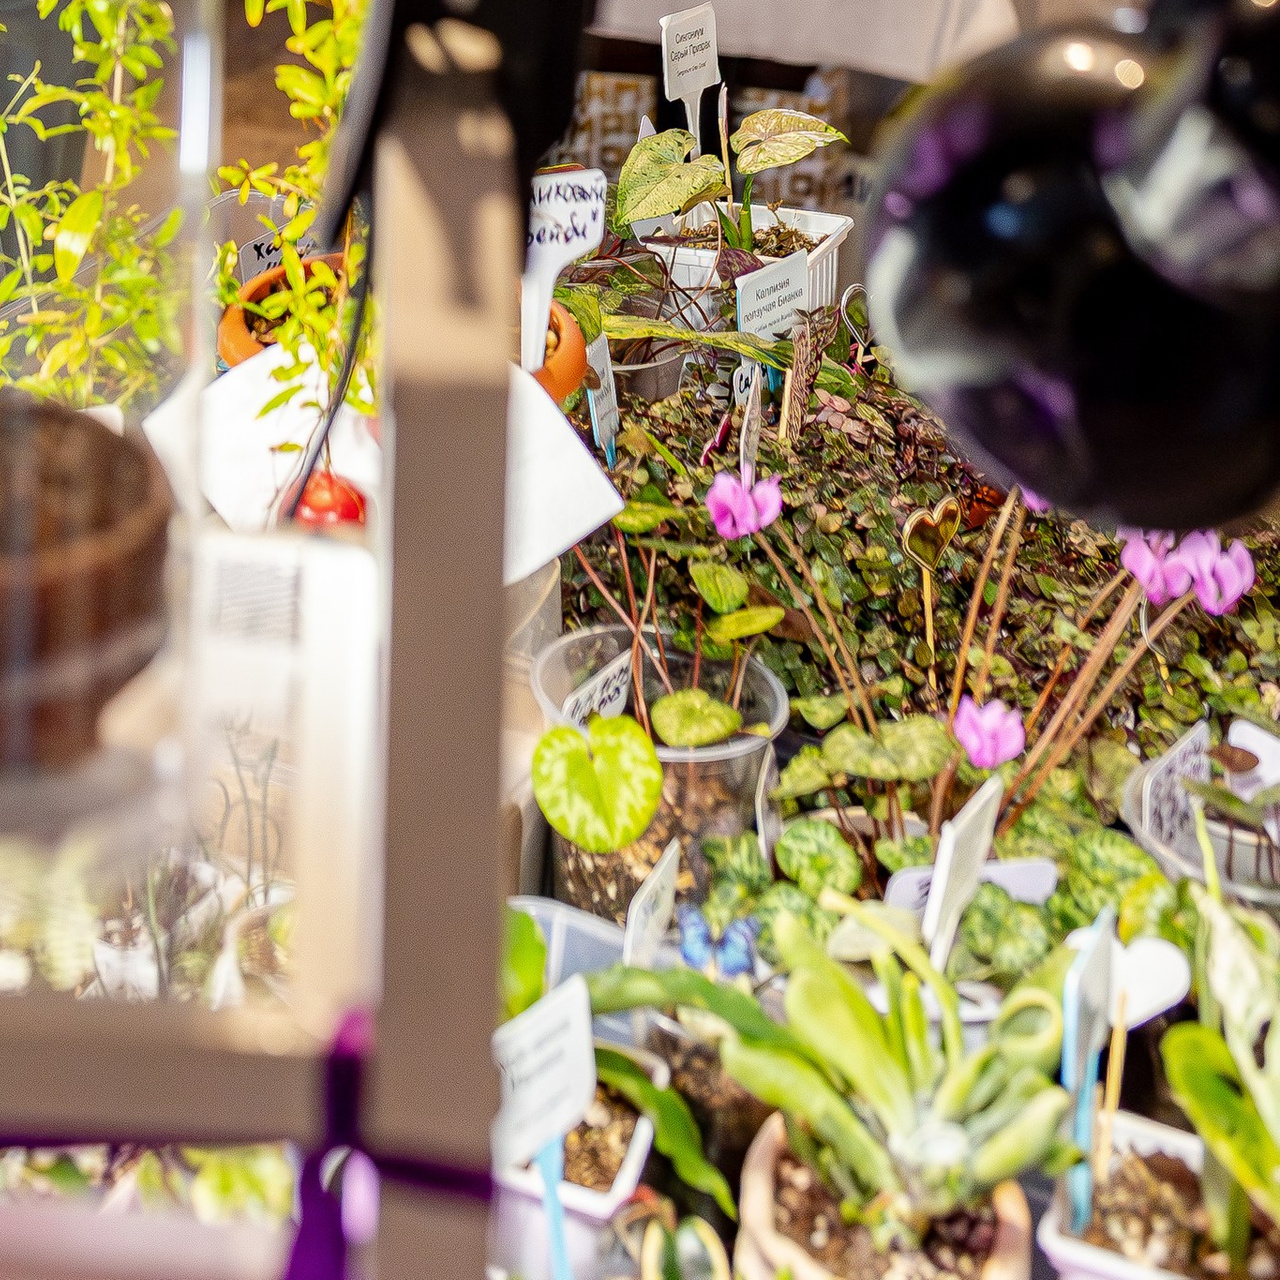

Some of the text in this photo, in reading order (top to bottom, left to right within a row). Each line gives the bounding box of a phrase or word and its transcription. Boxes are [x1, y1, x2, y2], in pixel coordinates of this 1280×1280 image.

[755, 278, 790, 301] Каллизия
[743, 301, 776, 323] ползучая
[777, 288, 803, 307] Бианка
